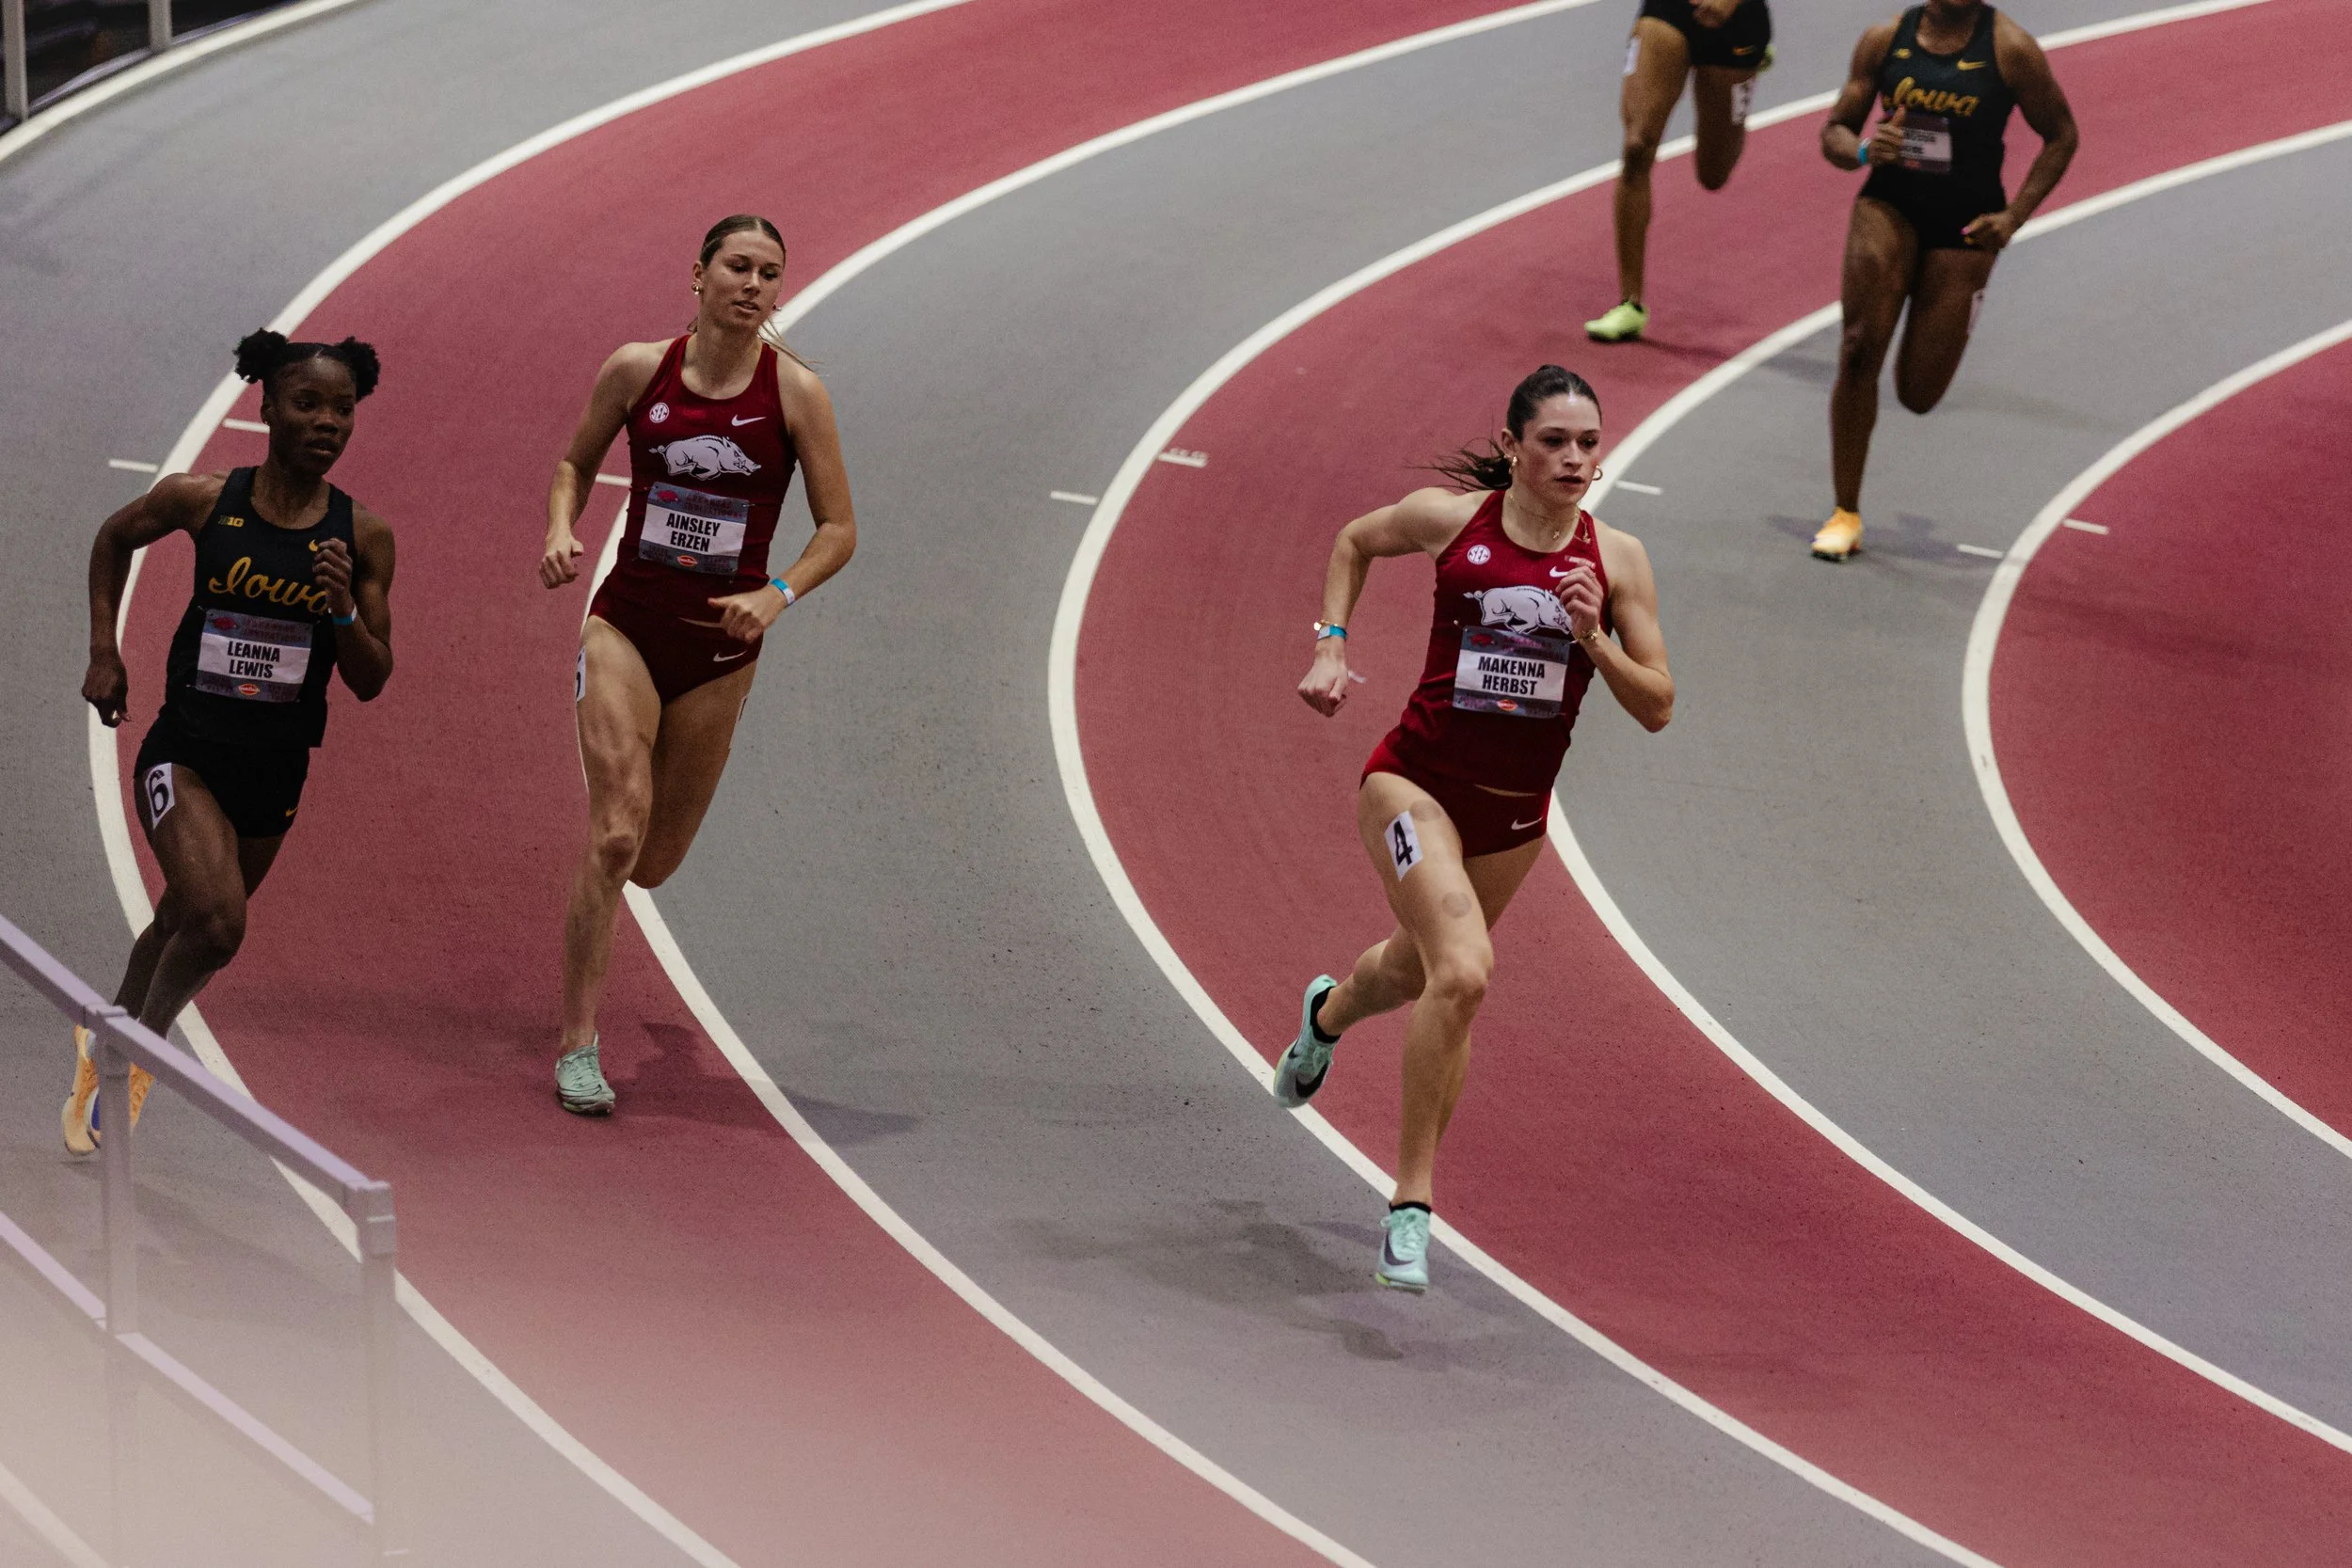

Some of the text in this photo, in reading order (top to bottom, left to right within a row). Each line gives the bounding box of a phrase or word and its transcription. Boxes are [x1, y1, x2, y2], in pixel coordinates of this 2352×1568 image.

[650, 404, 669, 421] SEC
[666, 514, 721, 536] AINSLEY
[670, 531, 710, 552] ERZEN
[1468, 546, 1490, 563] SEC
[228, 641, 280, 662] LEANNA
[229, 659, 273, 678] LEWIS
[1478, 657, 1545, 678] MAKENNA
[1482, 674, 1537, 695] HERBST
[149, 769, 169, 818] 6
[1393, 820, 1413, 866] 4
